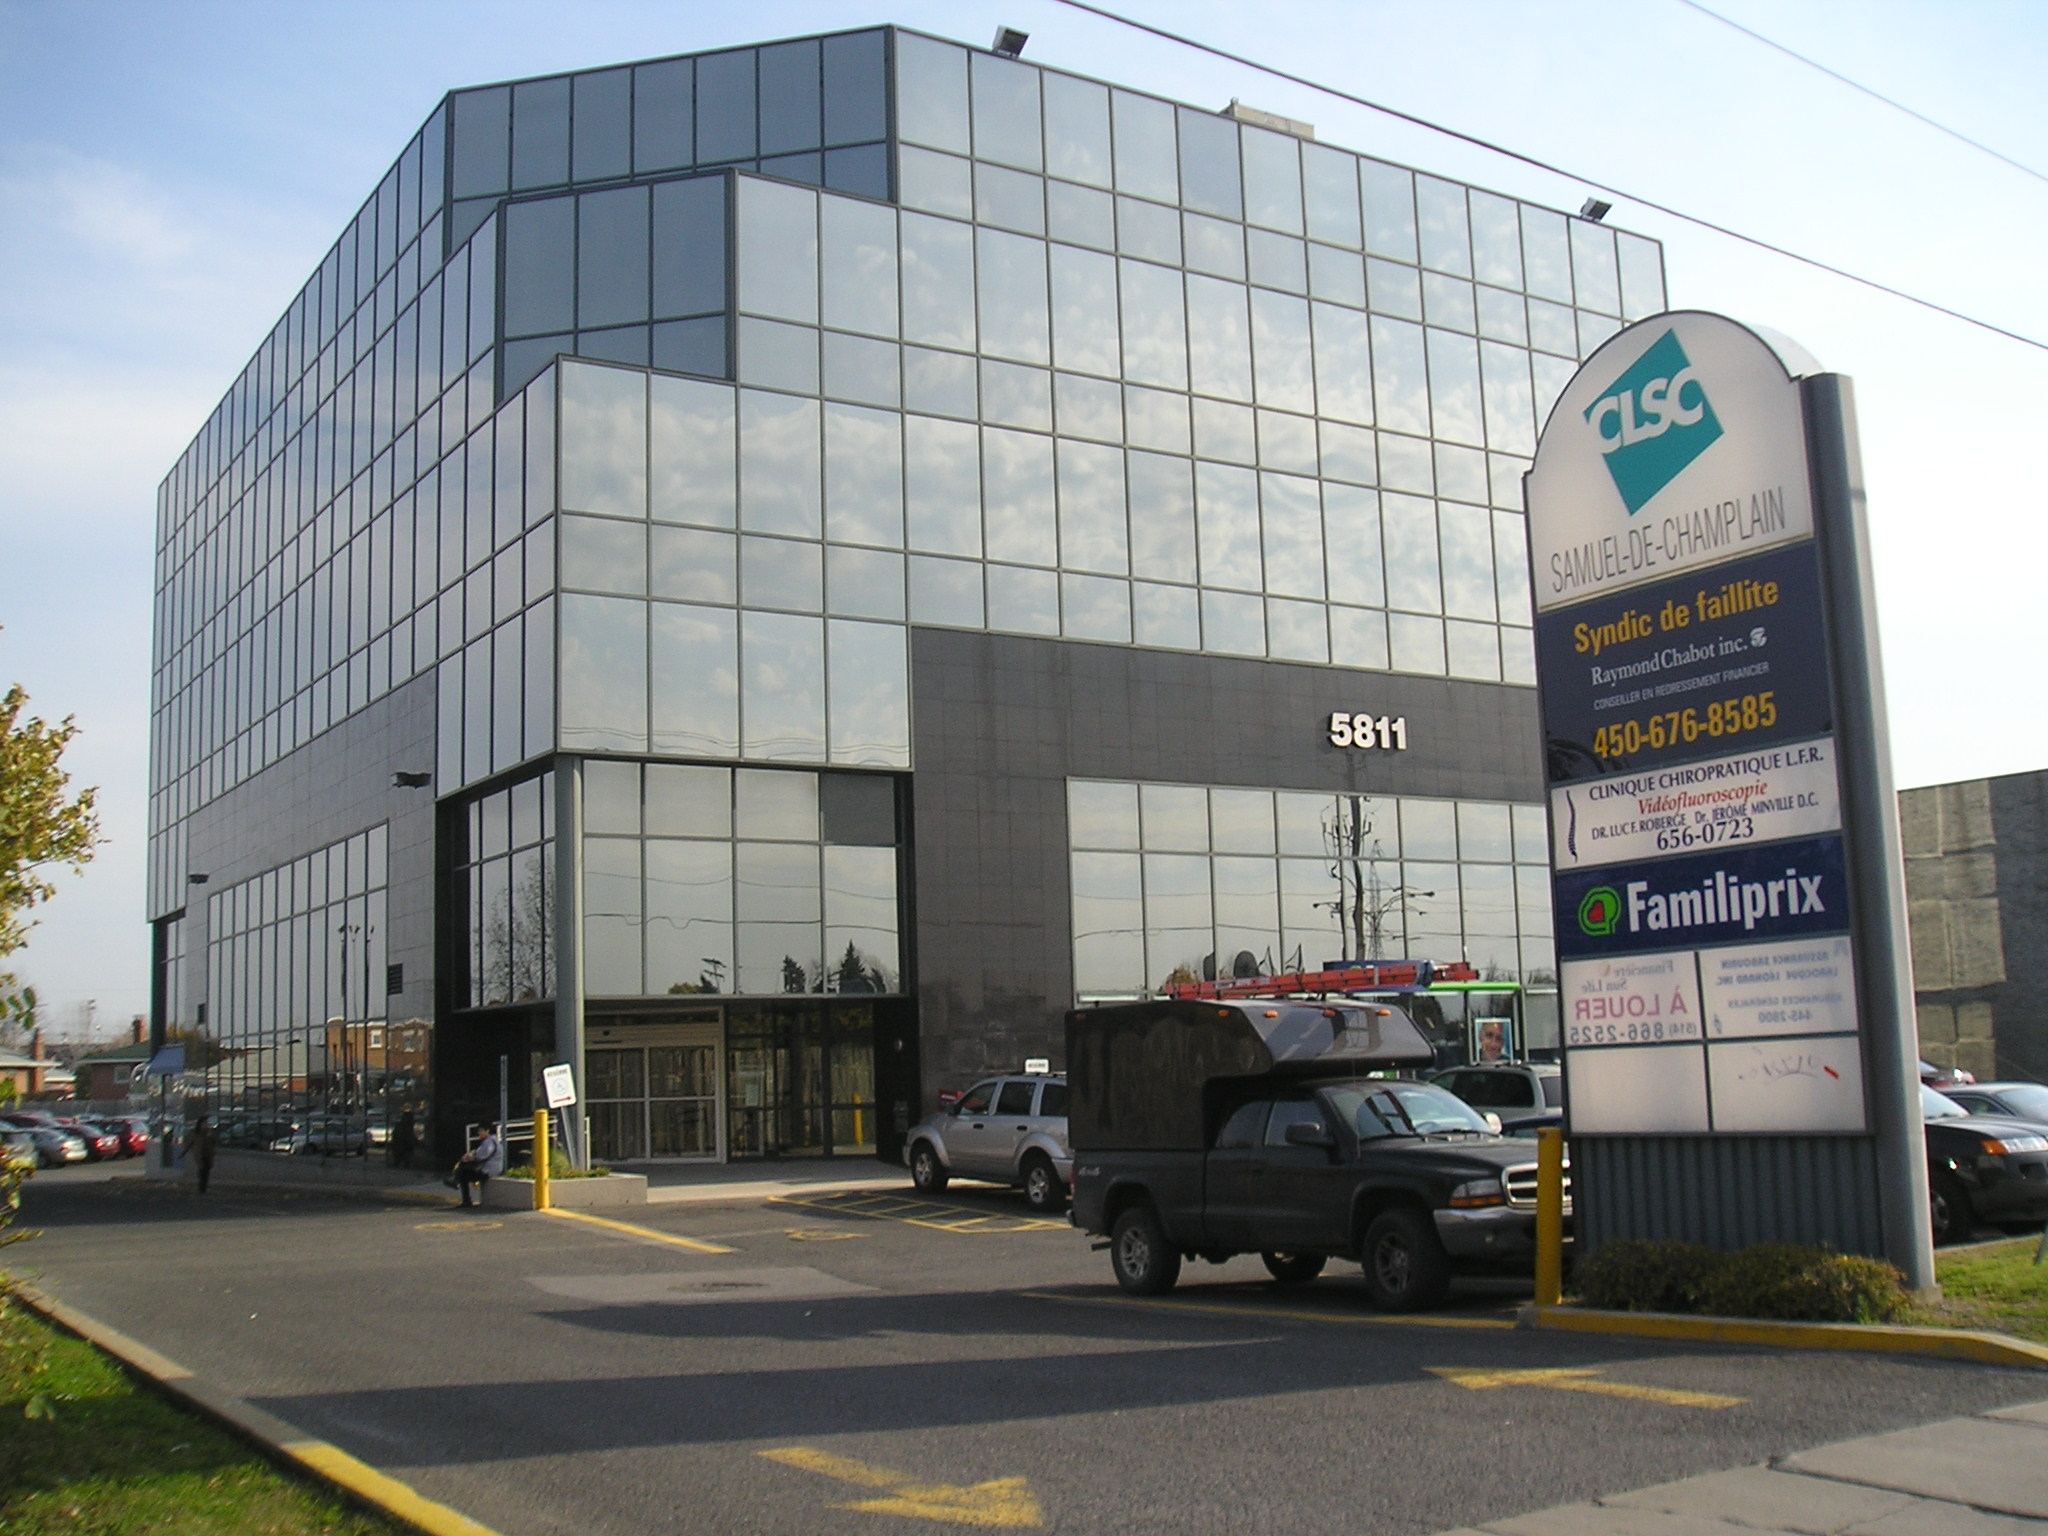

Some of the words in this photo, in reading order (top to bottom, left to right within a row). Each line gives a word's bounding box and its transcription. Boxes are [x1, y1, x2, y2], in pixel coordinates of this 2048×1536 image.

[1588, 366, 1704, 454] CLSC
[1551, 486, 1786, 593] SAMUEL-DE-CHAMPLAIN
[1574, 609, 1653, 656] Syndic
[1660, 600, 1690, 632] de
[1696, 579, 1779, 622] faillite
[1719, 636, 1748, 656] inc.
[1593, 689, 1641, 710] CONSEILLER
[1642, 687, 1655, 701] EN
[1655, 674, 1721, 698] REDRESSEMENT
[1722, 661, 1770, 683] FINANCIER
[1330, 712, 1407, 750] 5811
[1593, 691, 1777, 759] 450-676-8585
[1589, 776, 1655, 801] CLINIQUE
[1659, 752, 1782, 789] CHIROPRATIQUE
[1786, 746, 1824, 768] L.F.R.
[1638, 779, 1769, 816] Vidéofluoroscopie
[1656, 816, 1754, 851] 656-0723
[1694, 810, 1709, 824] Dr.
[1751, 795, 1794, 815] MINVILLE
[1797, 791, 1819, 808] D.C.
[1626, 868, 1826, 933] Familiprix
